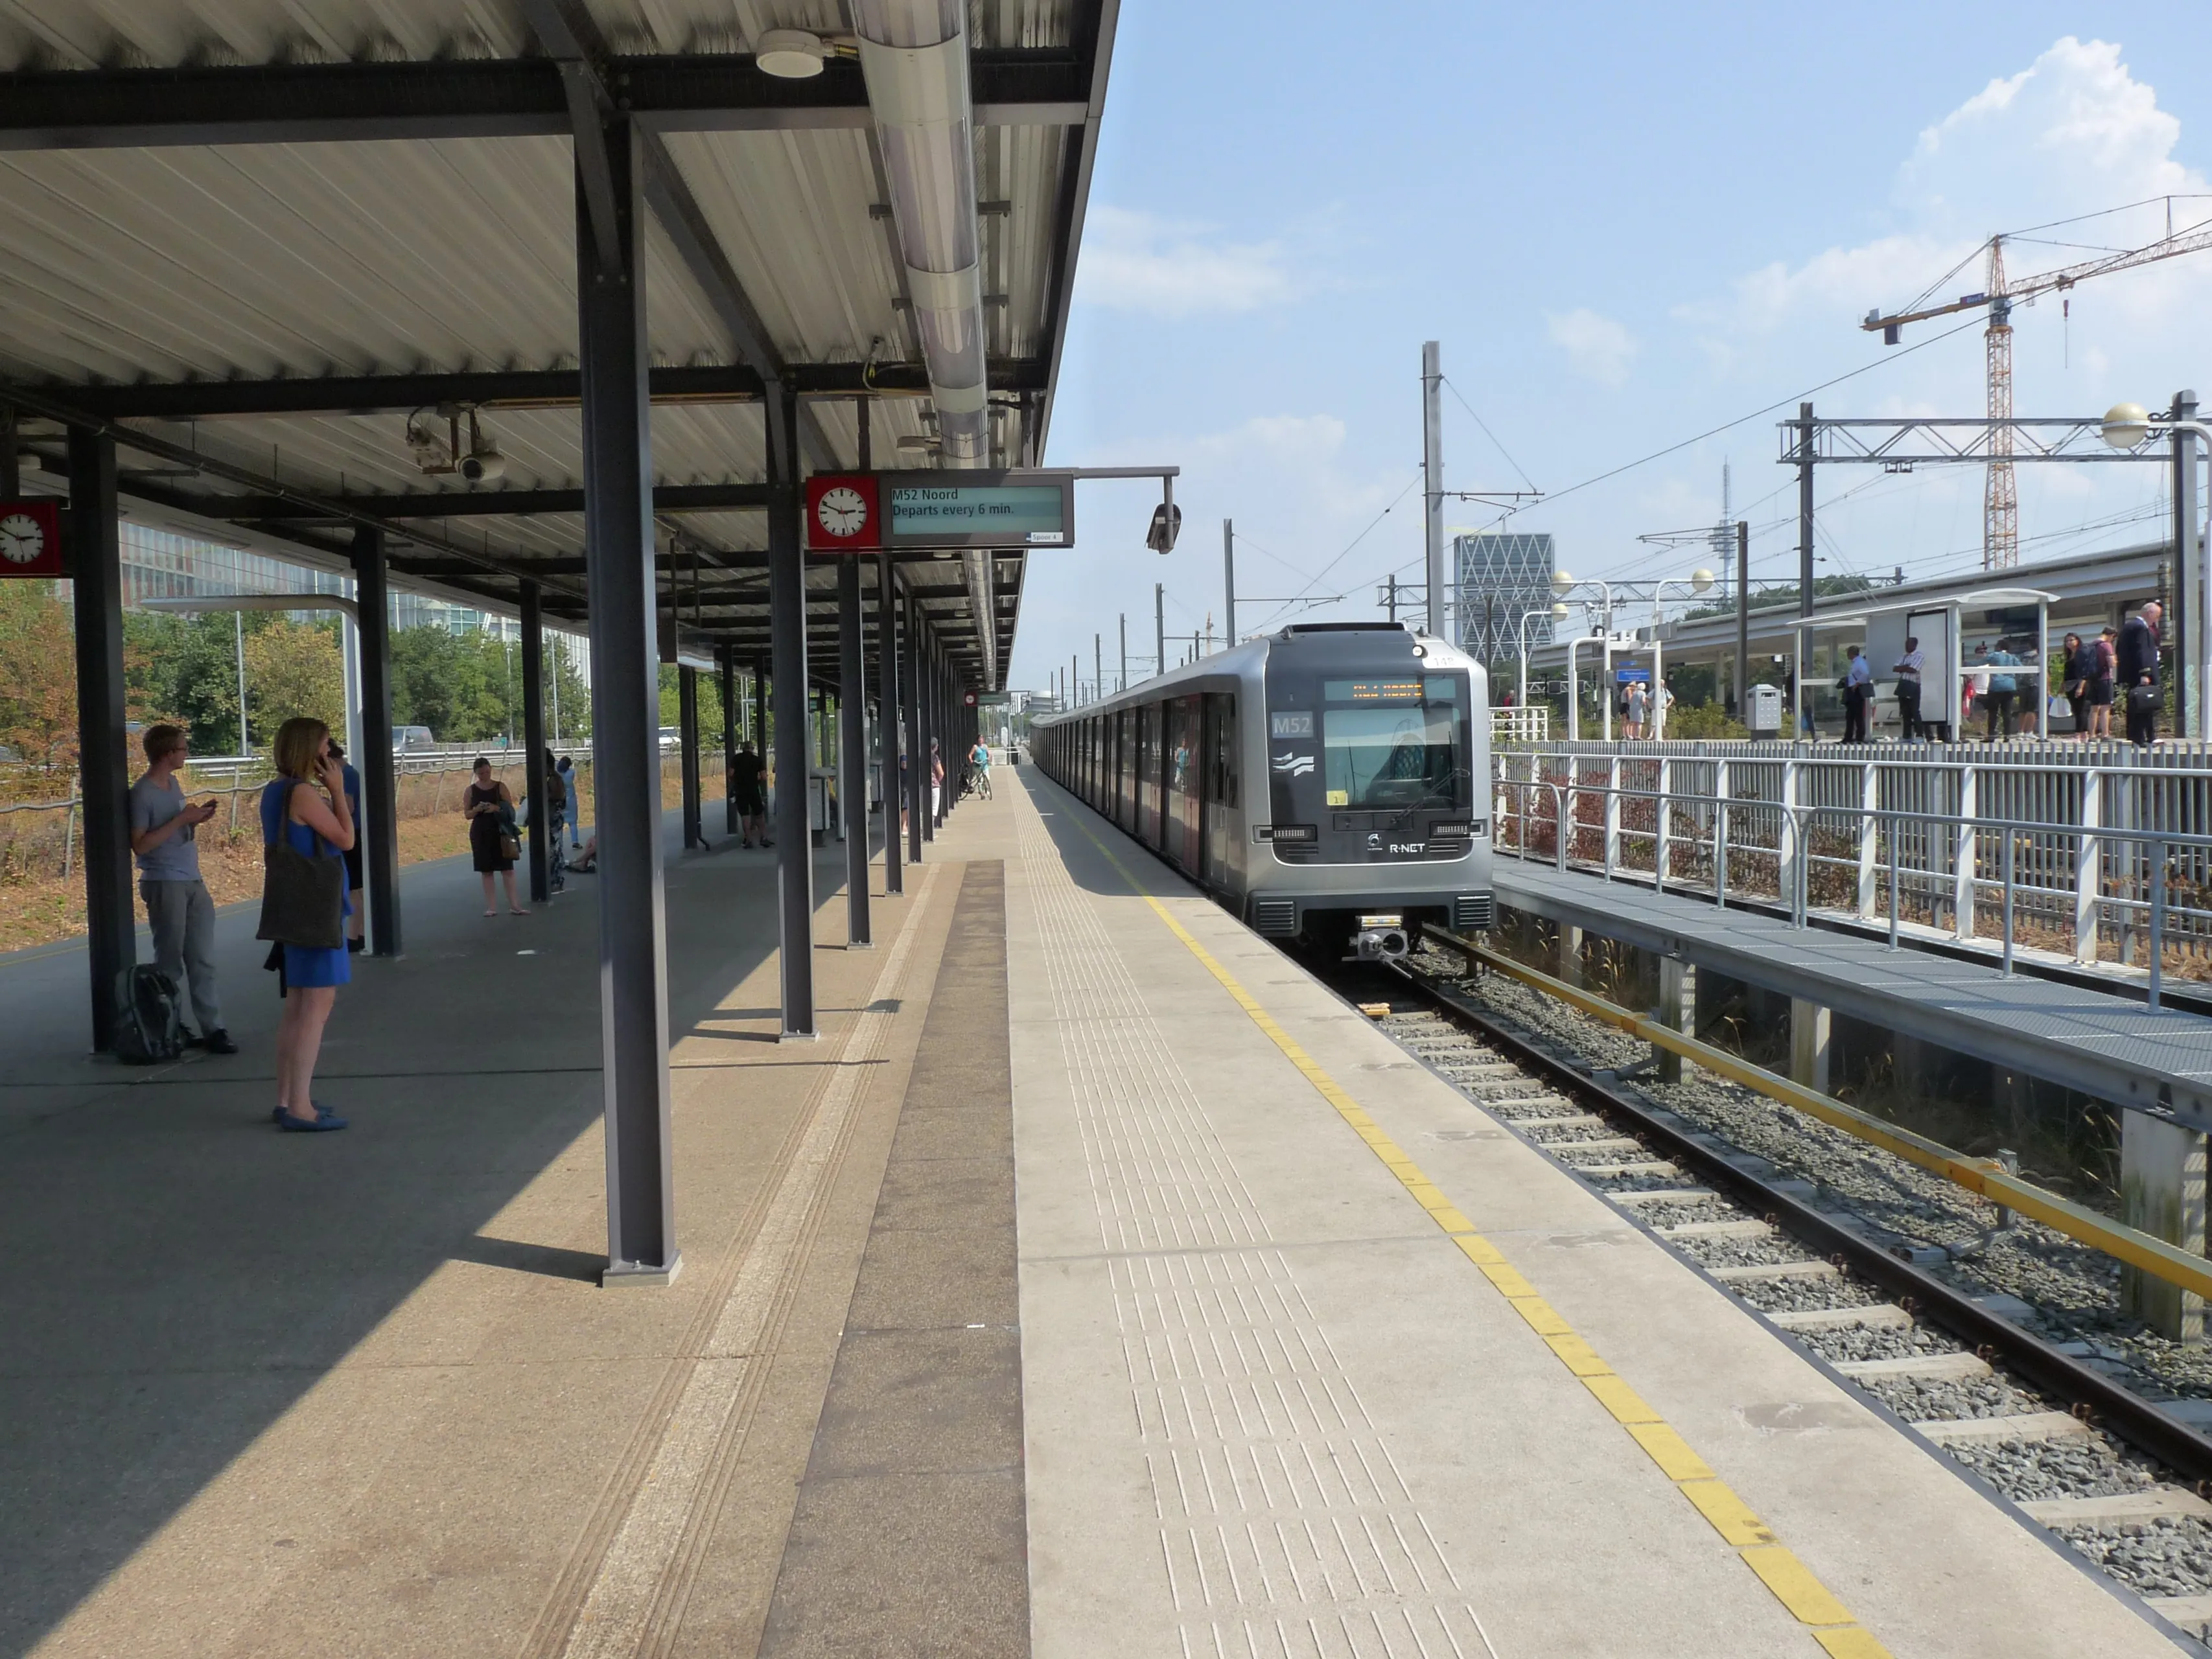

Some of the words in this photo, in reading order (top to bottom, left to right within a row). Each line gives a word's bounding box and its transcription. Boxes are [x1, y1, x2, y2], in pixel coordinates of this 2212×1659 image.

[892, 490, 918, 500] M52
[922, 489, 959, 500] Noord
[892, 504, 938, 518] Departs
[942, 505, 974, 517] every
[979, 504, 985, 515] 6
[989, 504, 1014, 515] min.
[1274, 717, 1310, 733] M52
